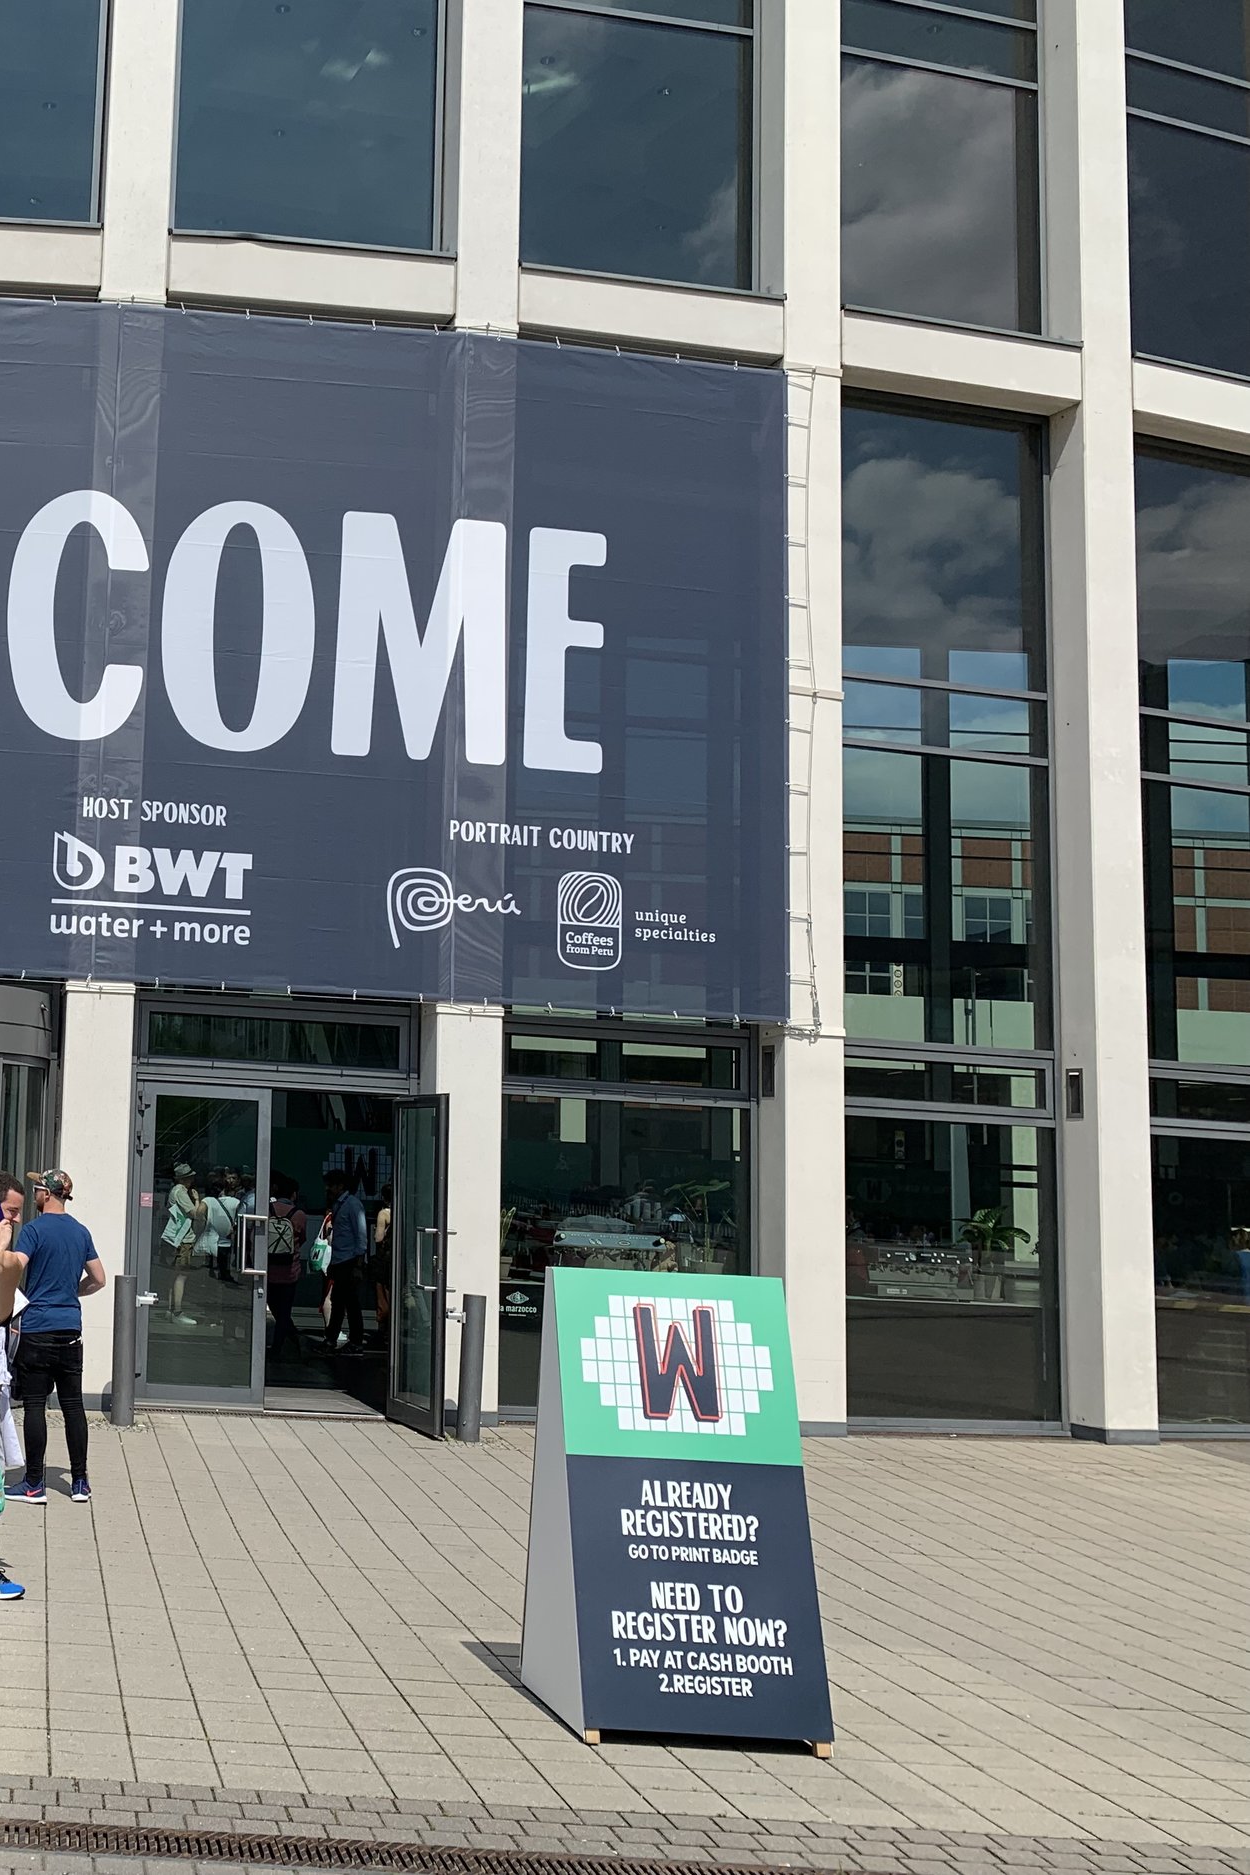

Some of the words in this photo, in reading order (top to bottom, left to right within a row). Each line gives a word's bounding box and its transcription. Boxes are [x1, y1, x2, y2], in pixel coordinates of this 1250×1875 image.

[82, 796, 133, 820] HOST
[141, 800, 227, 827] SPONSOR
[449, 819, 542, 847] PORTRAIT
[549, 827, 635, 854] COUNTRY
[113, 845, 253, 900] BWT
[50, 912, 144, 938] water
[174, 921, 251, 945] more
[635, 910, 687, 925] unique
[565, 931, 614, 947] Coffees
[634, 926, 717, 943] specialties
[566, 944, 590, 955] from
[591, 945, 614, 957] Peru
[506, 1305, 537, 1313] marzocco
[633, 1303, 723, 1423] W
[640, 1479, 732, 1510] ALREADY
[621, 1510, 759, 1542] REGISTERED?
[628, 1545, 648, 1561] GO
[649, 1545, 670, 1561] TO
[671, 1546, 711, 1564] PRINT
[712, 1548, 759, 1567] BADGE
[650, 1581, 701, 1612] NEED
[707, 1583, 744, 1614] TO
[611, 1610, 717, 1645] REGISTER
[724, 1617, 788, 1648] NOW?
[613, 1647, 627, 1667] 1.
[629, 1648, 661, 1669] PAY
[663, 1650, 685, 1669] AT
[687, 1651, 734, 1673] CASH
[736, 1654, 793, 1676] BOOTH
[659, 1673, 754, 1698] 2.REGISTER
